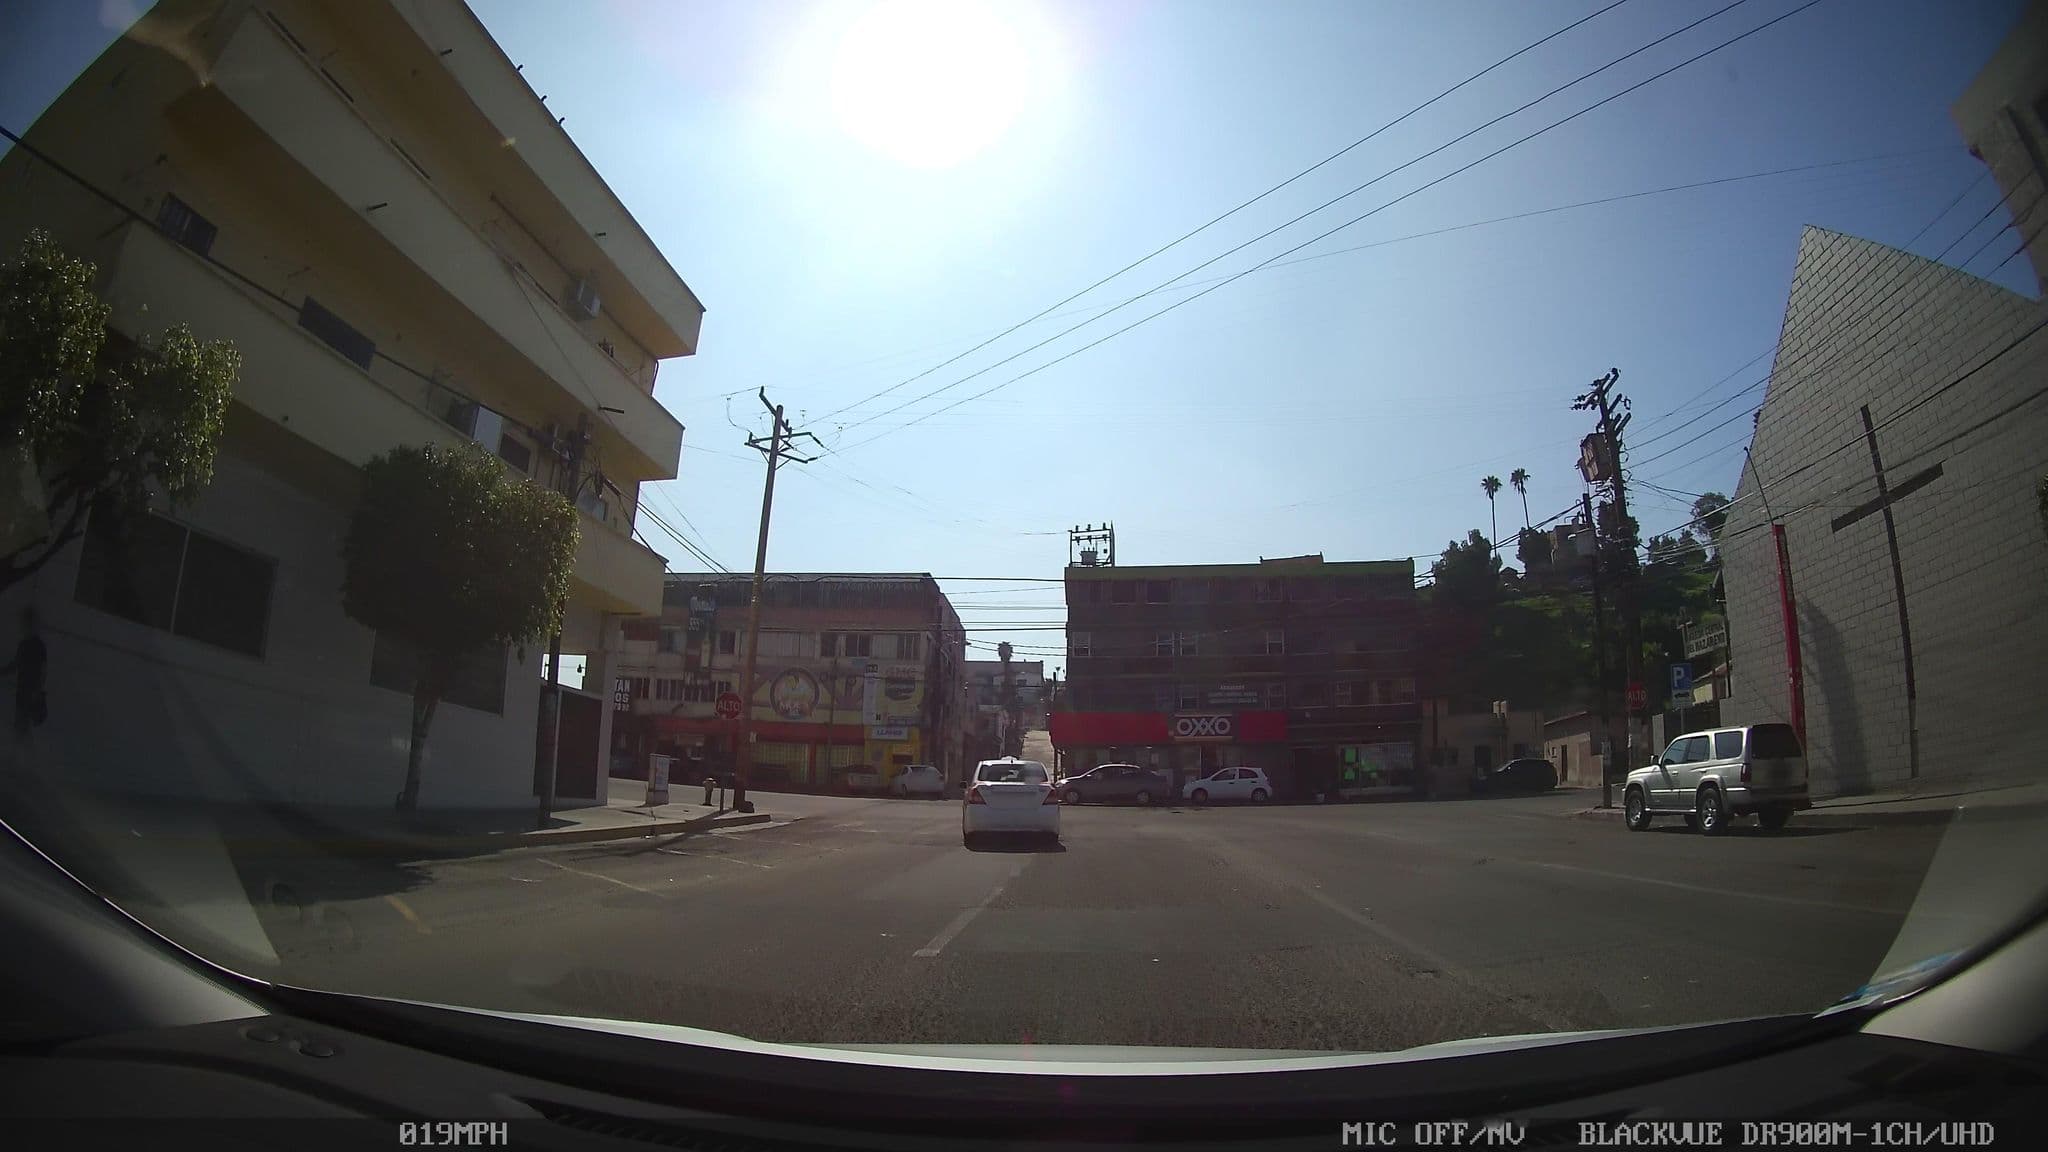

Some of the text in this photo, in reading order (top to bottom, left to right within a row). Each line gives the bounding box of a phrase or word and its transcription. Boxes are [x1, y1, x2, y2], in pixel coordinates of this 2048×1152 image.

[1673, 667, 1684, 687] P
[1627, 690, 1647, 701] ALTO
[717, 700, 742, 711] ALTO
[1177, 716, 1231, 737] OXXO
